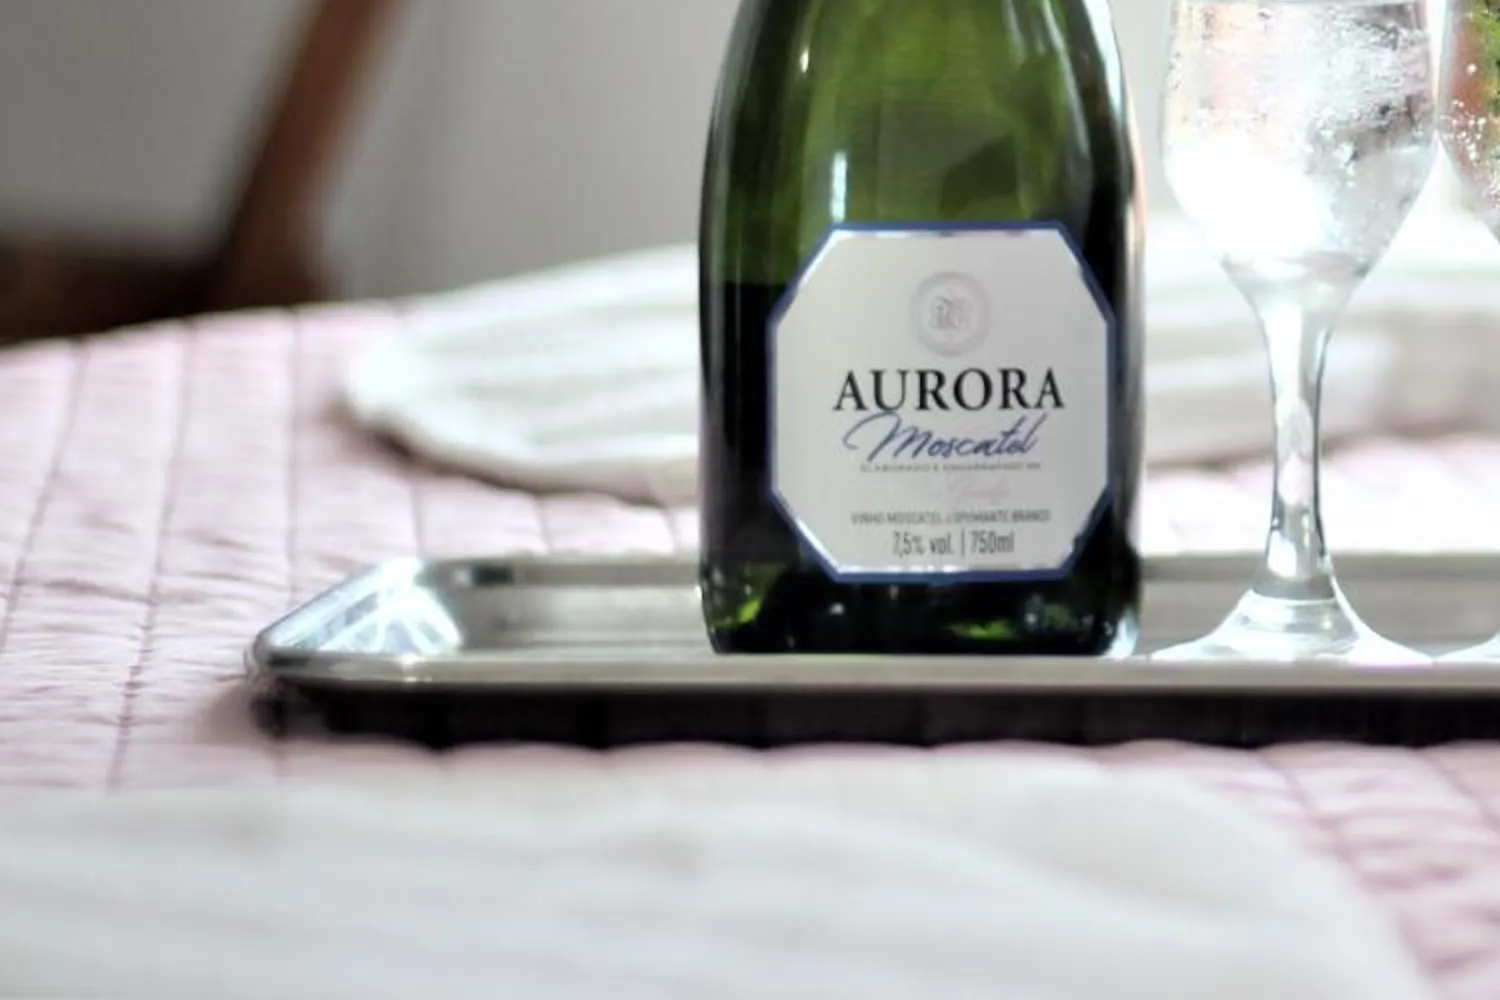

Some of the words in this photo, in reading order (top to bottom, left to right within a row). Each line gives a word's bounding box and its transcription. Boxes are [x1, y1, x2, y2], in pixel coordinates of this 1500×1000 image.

[833, 366, 1066, 412] AURORA
[842, 410, 1048, 462] Moscatel
[970, 530, 1015, 553] 750ml
